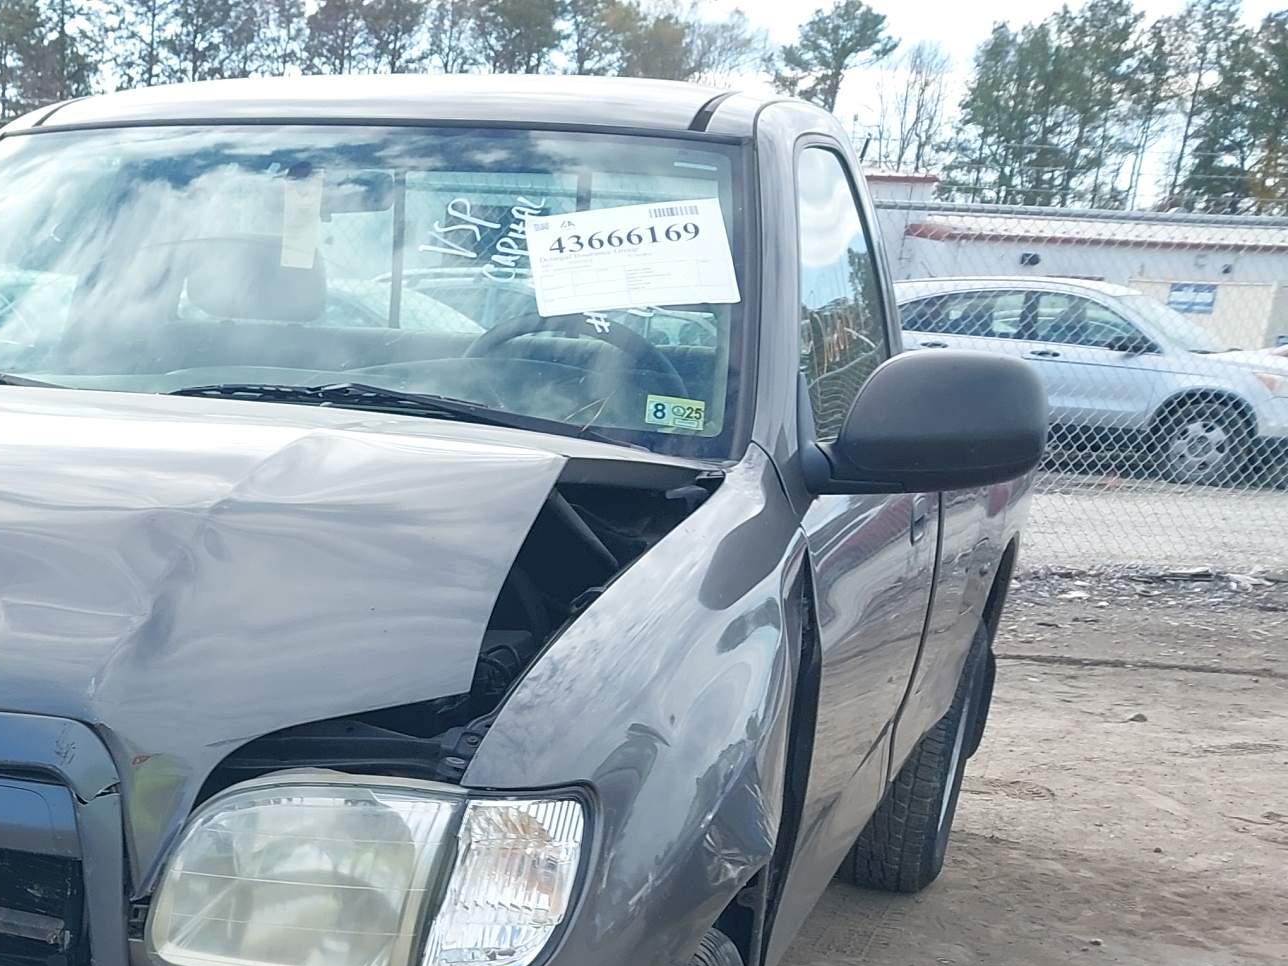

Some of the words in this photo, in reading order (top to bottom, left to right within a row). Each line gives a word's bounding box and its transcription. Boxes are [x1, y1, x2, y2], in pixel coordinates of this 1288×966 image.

[418, 198, 502, 259] VSP
[548, 221, 701, 254] 43666169
[653, 402, 666, 420] 8
[685, 406, 703, 421] 25
